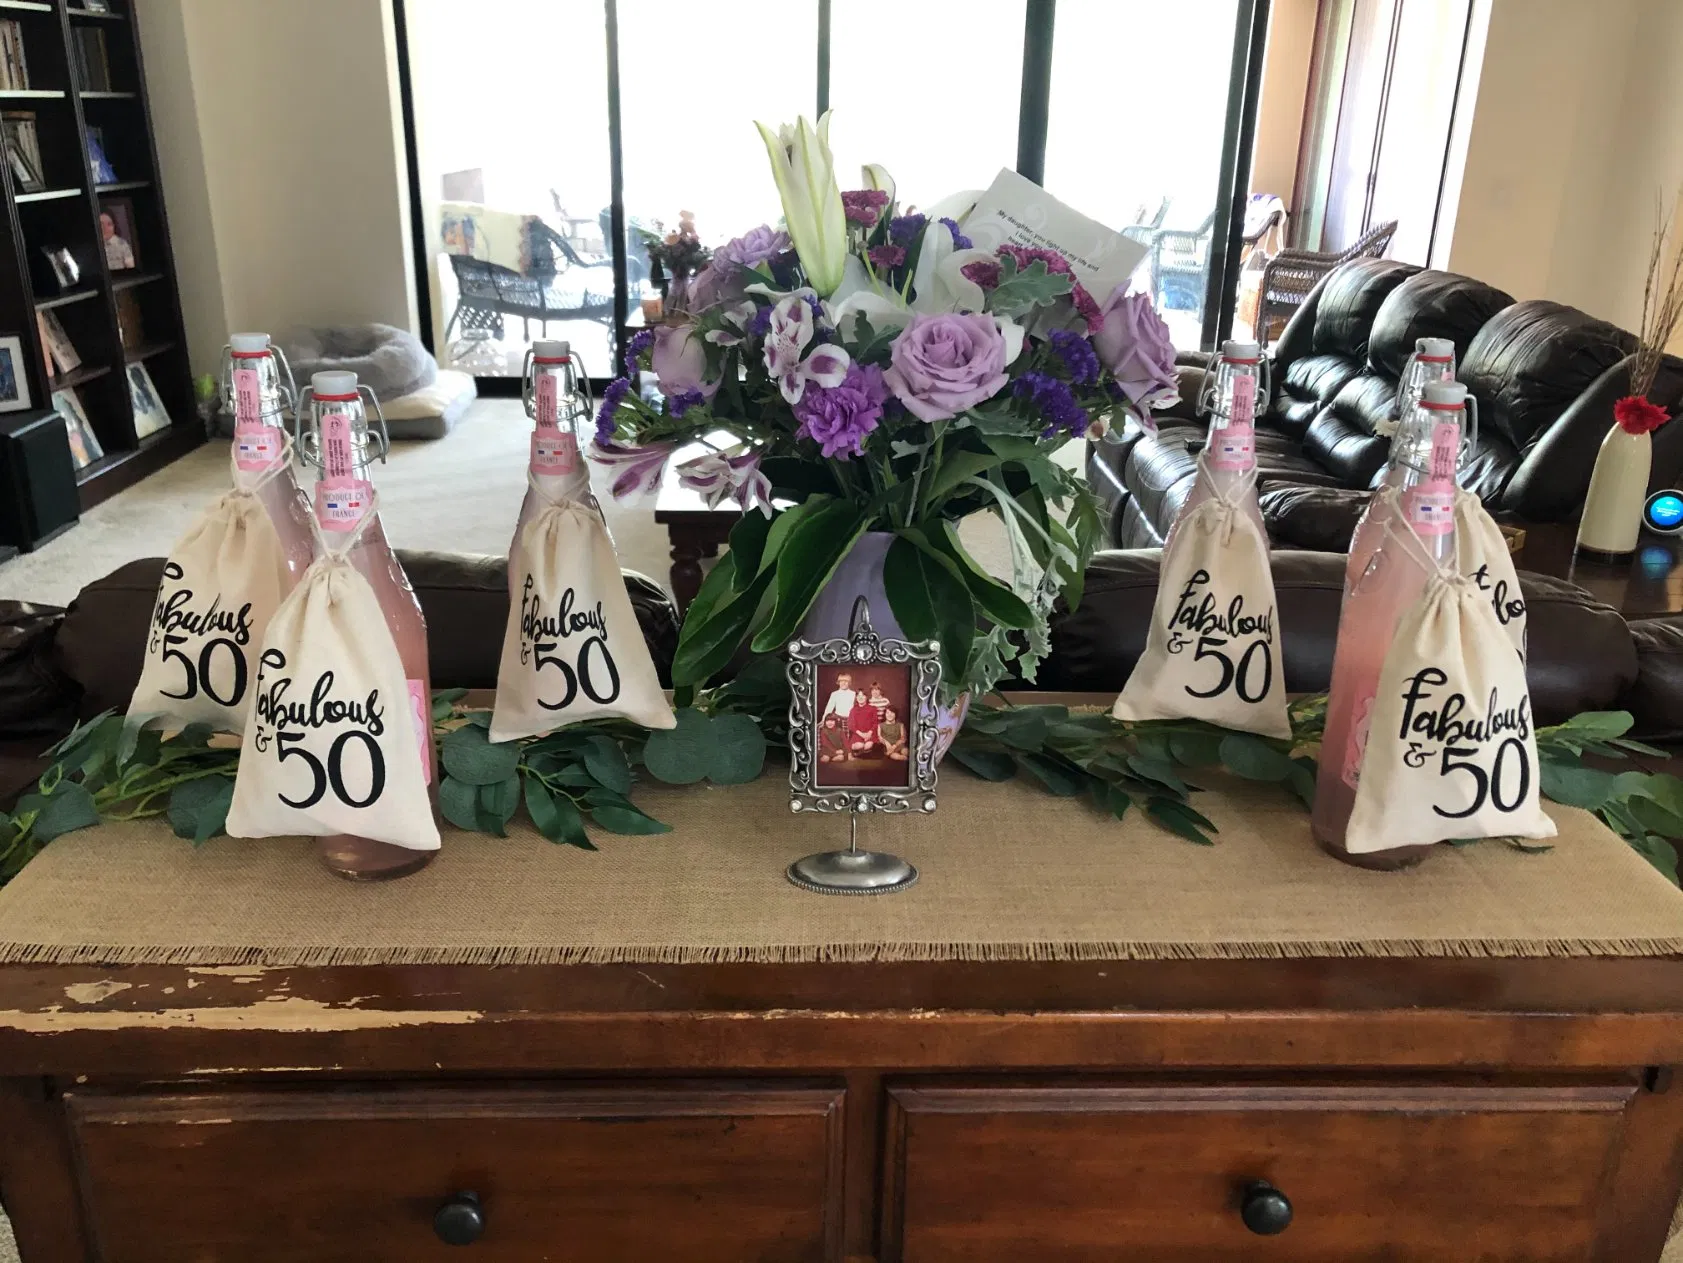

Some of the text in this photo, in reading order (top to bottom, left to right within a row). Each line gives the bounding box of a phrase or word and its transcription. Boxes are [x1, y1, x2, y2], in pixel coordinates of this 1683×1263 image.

[998, 209, 1006, 219] My
[159, 634, 248, 707] 50
[534, 635, 621, 711] 50
[1167, 631, 1272, 704] & 50
[276, 730, 386, 809] 50
[1403, 737, 1530, 818] & 50
